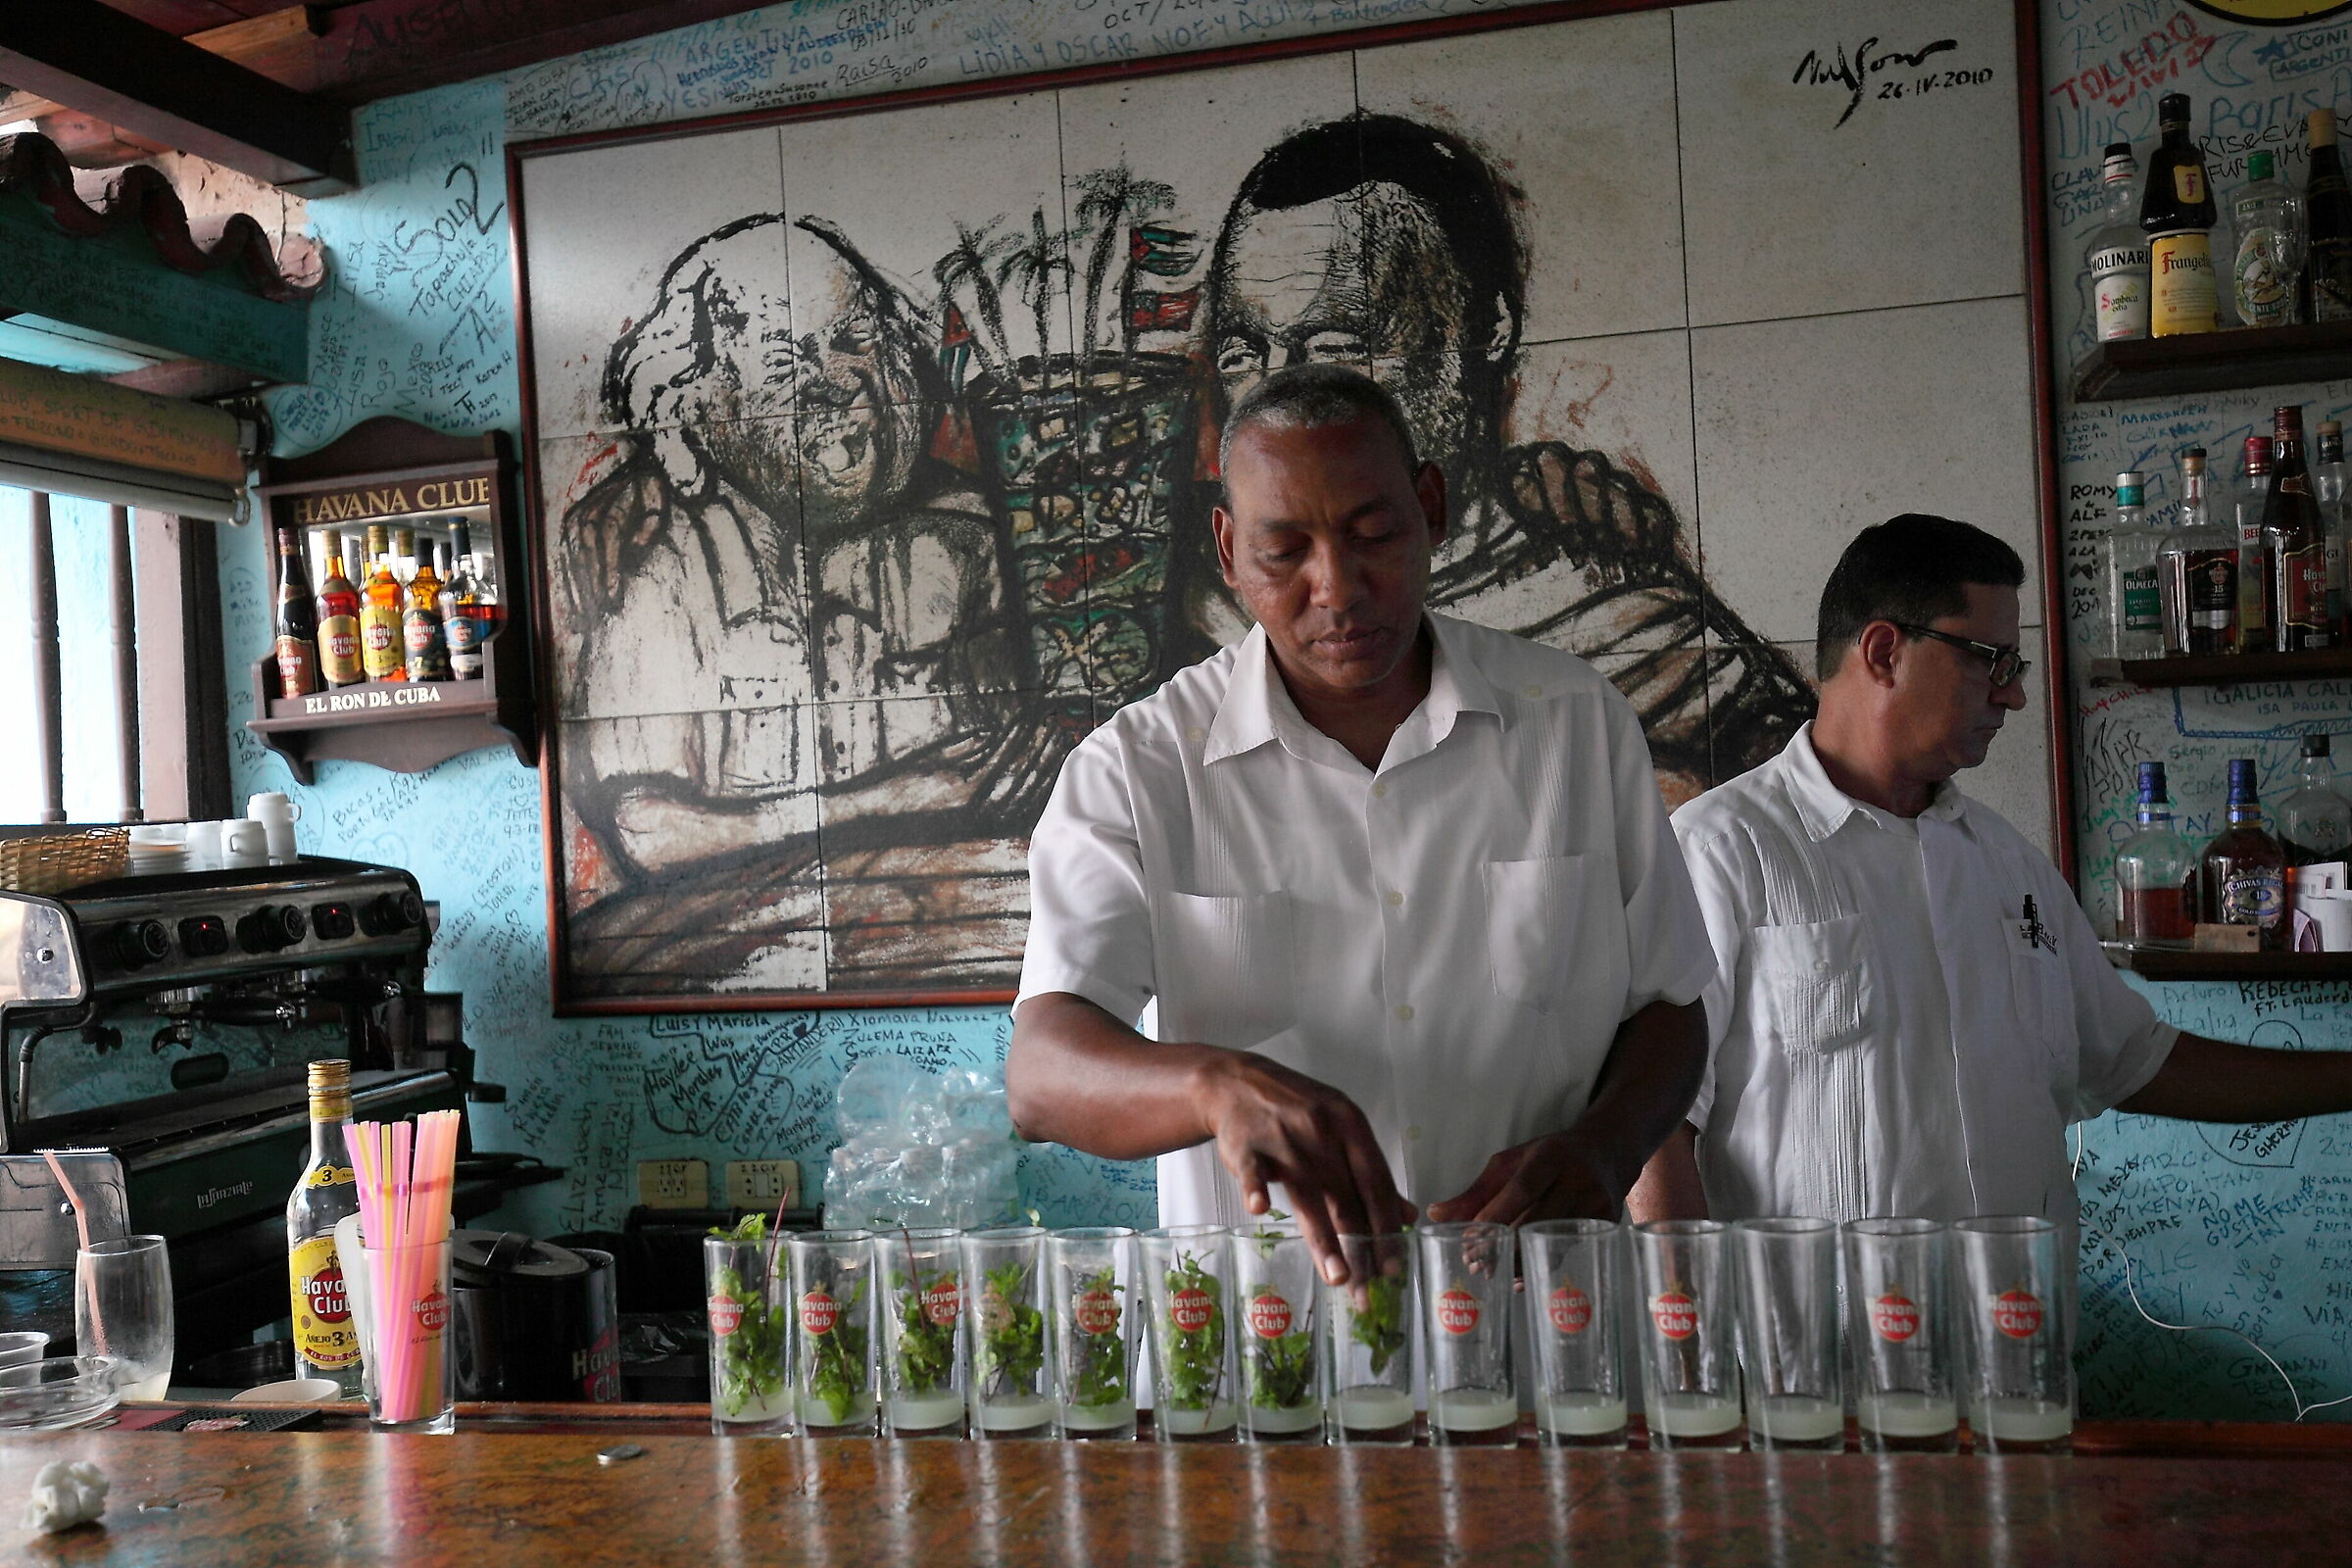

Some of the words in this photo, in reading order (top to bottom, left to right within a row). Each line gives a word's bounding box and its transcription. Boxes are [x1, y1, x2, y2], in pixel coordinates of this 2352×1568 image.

[1056, 31, 1138, 65] OSCAR
[789, 51, 833, 74] 2010
[2050, 11, 2197, 110] TOLEDO
[836, 55, 896, 86] Raisa
[891, 56, 929, 83] 2010
[2091, 250, 2149, 272] MOLINARI
[2070, 483, 2118, 502] ROMY
[296, 488, 411, 525] HAVANA
[2125, 579, 2160, 590] OLMECA
[306, 697, 328, 714] EL
[330, 691, 366, 711] RON
[368, 689, 392, 707] DE
[394, 686, 442, 705] CUBA
[2292, 700, 2338, 713] PAULA
[321, 1170, 332, 1183] 3
[803, 1312, 831, 1326] Club
[931, 1303, 957, 1319] Club
[1081, 1310, 1113, 1326] Club
[1176, 1310, 1207, 1324] Club
[1441, 1310, 1472, 1326] Club
[1554, 1308, 1588, 1324] Club
[711, 1314, 735, 1328] Club
[1254, 1315, 1286, 1330] Club
[1658, 1314, 1692, 1331] Club
[1879, 1314, 1913, 1331] Club
[1999, 1313, 2035, 1330] Club
[331, 1331, 345, 1348] 3
